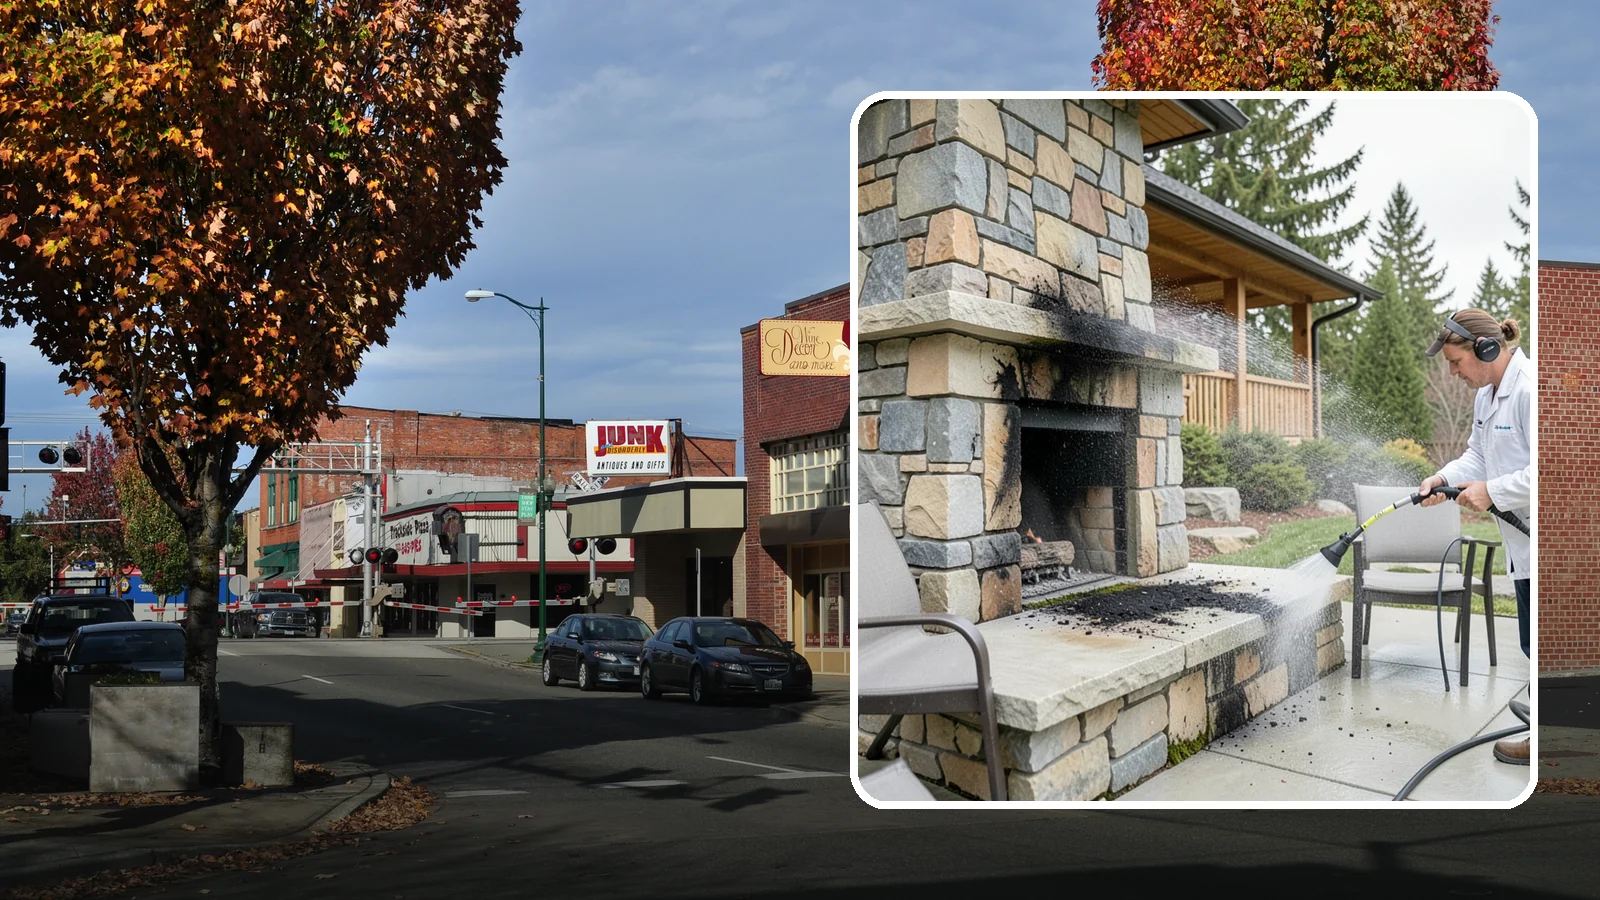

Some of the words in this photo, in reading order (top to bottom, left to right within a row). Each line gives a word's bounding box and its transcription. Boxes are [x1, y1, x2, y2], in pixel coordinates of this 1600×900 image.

[596, 425, 665, 457] JUNK
[608, 446, 645, 454] DISORDERLY
[597, 461, 628, 470] ANTIQUES
[631, 461, 643, 470] AND
[647, 461, 665, 469] GIFTS
[353, 498, 364, 510] CRO
[415, 519, 429, 534] Pizza
